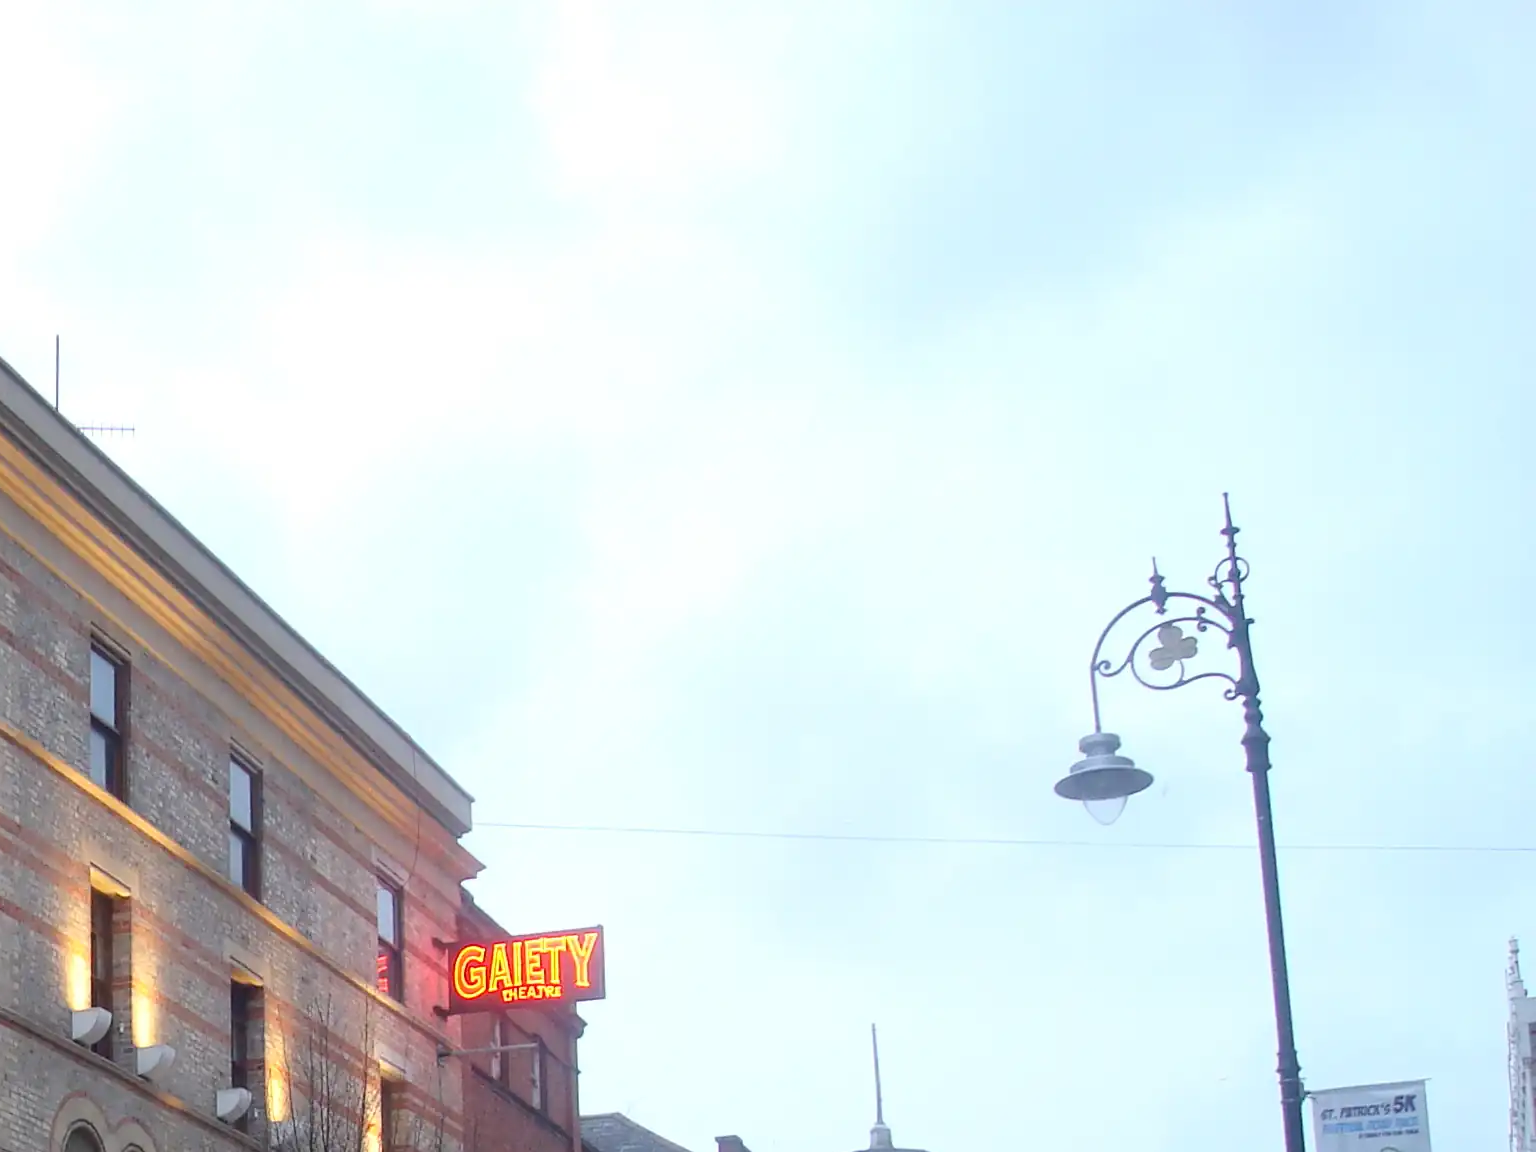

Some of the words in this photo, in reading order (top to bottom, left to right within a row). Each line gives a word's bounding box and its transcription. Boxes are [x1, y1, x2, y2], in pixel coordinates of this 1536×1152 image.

[454, 932, 598, 999] GAIETY
[502, 985, 562, 1003] THEATRE
[1393, 1094, 1418, 1113] 5K
